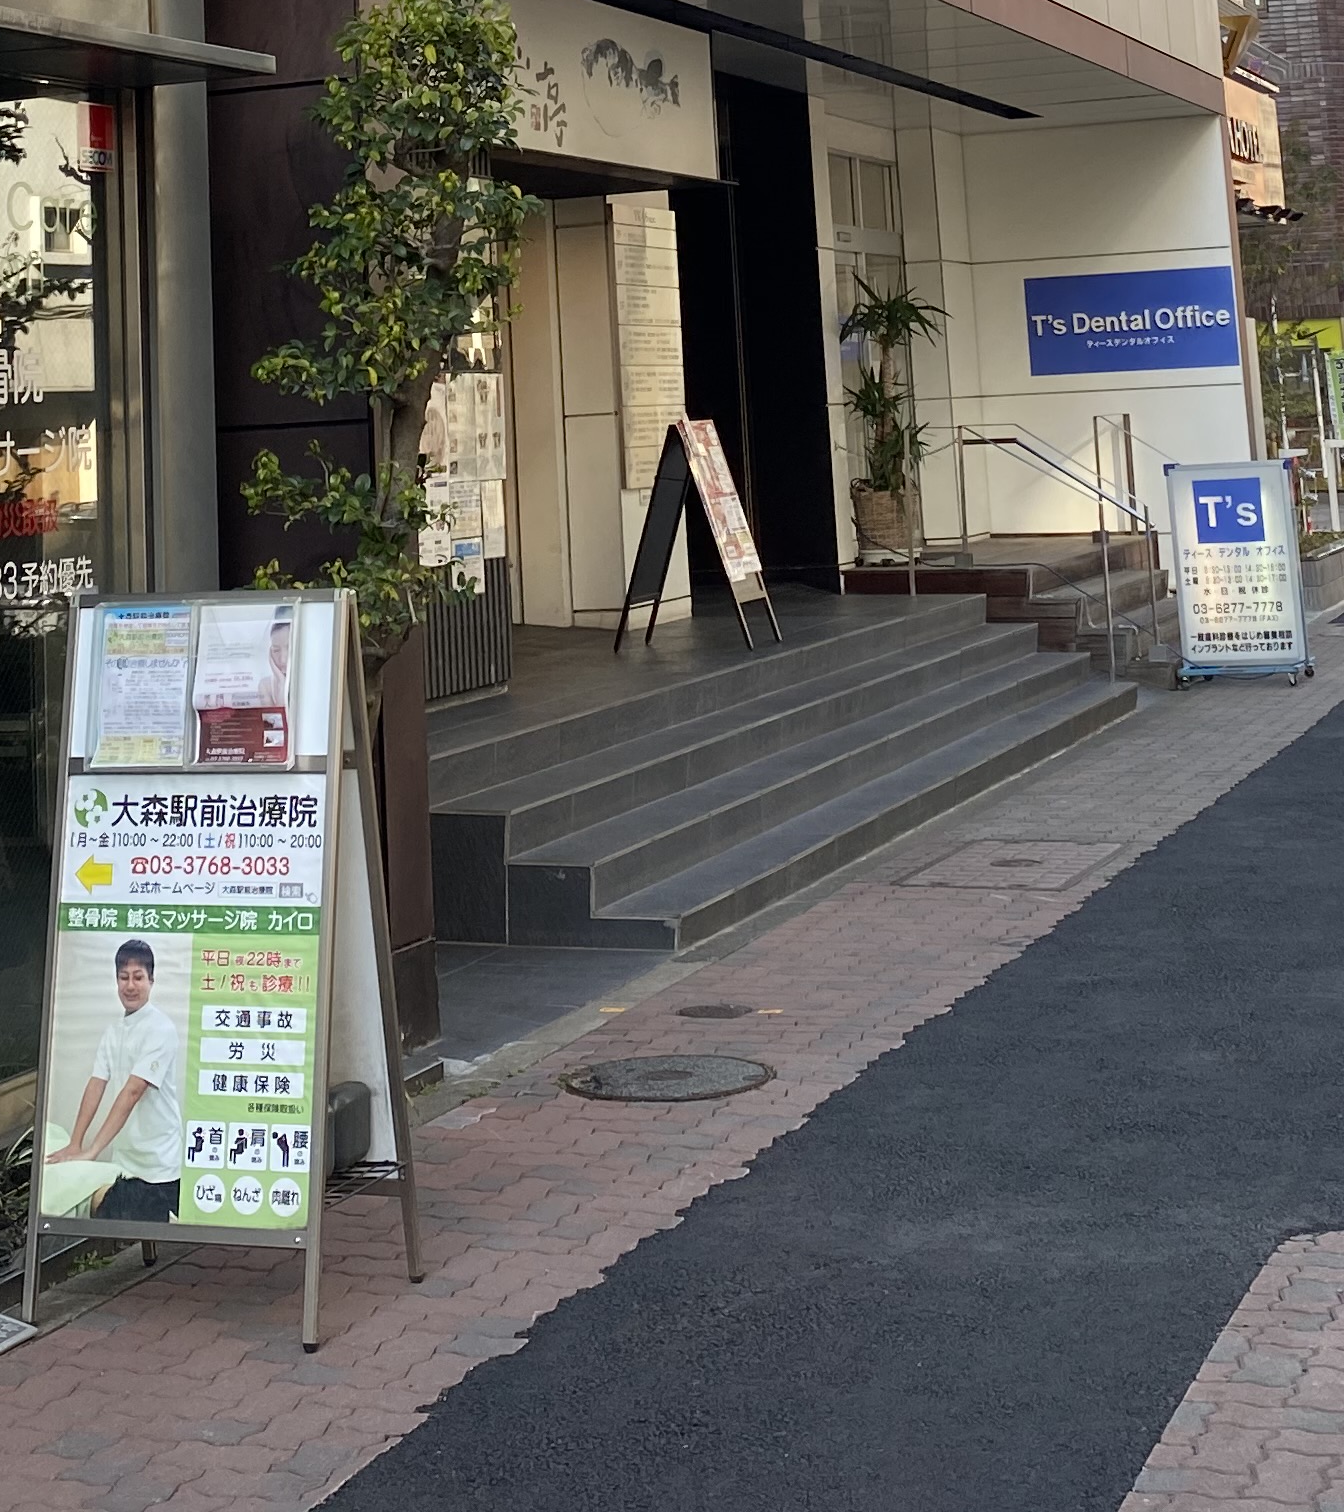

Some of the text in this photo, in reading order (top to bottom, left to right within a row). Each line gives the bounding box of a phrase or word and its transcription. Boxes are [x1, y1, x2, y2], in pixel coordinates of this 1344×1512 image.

[82, 149, 113, 166] SECOM
[6, 181, 99, 238] Care
[1032, 305, 1231, 336] T's Dental Office
[1087, 335, 1175, 348] ティースデンタルオフィス
[1198, 495, 1258, 528] T's
[1219, 547, 1250, 558] デンタル
[1256, 545, 1285, 556] オフィス
[21, 554, 94, 597] 予約優先
[111, 794, 319, 829] 大森駅前治療院
[150, 855, 290, 876] 03-3768-3033
[129, 880, 216, 895] 公式ホームページ
[68, 907, 313, 931] 整骨院 鍼灸マッサージ院 カイロ
[202, 950, 230, 967] 平日
[215, 1009, 294, 1029] 交通事故
[228, 1041, 276, 1061] 労災
[212, 1073, 291, 1095] 健康保険
[209, 1127, 224, 1145] 首
[250, 1128, 266, 1148] 肩
[293, 1130, 309, 1149] 腰
[232, 1187, 261, 1203] ねんざ
